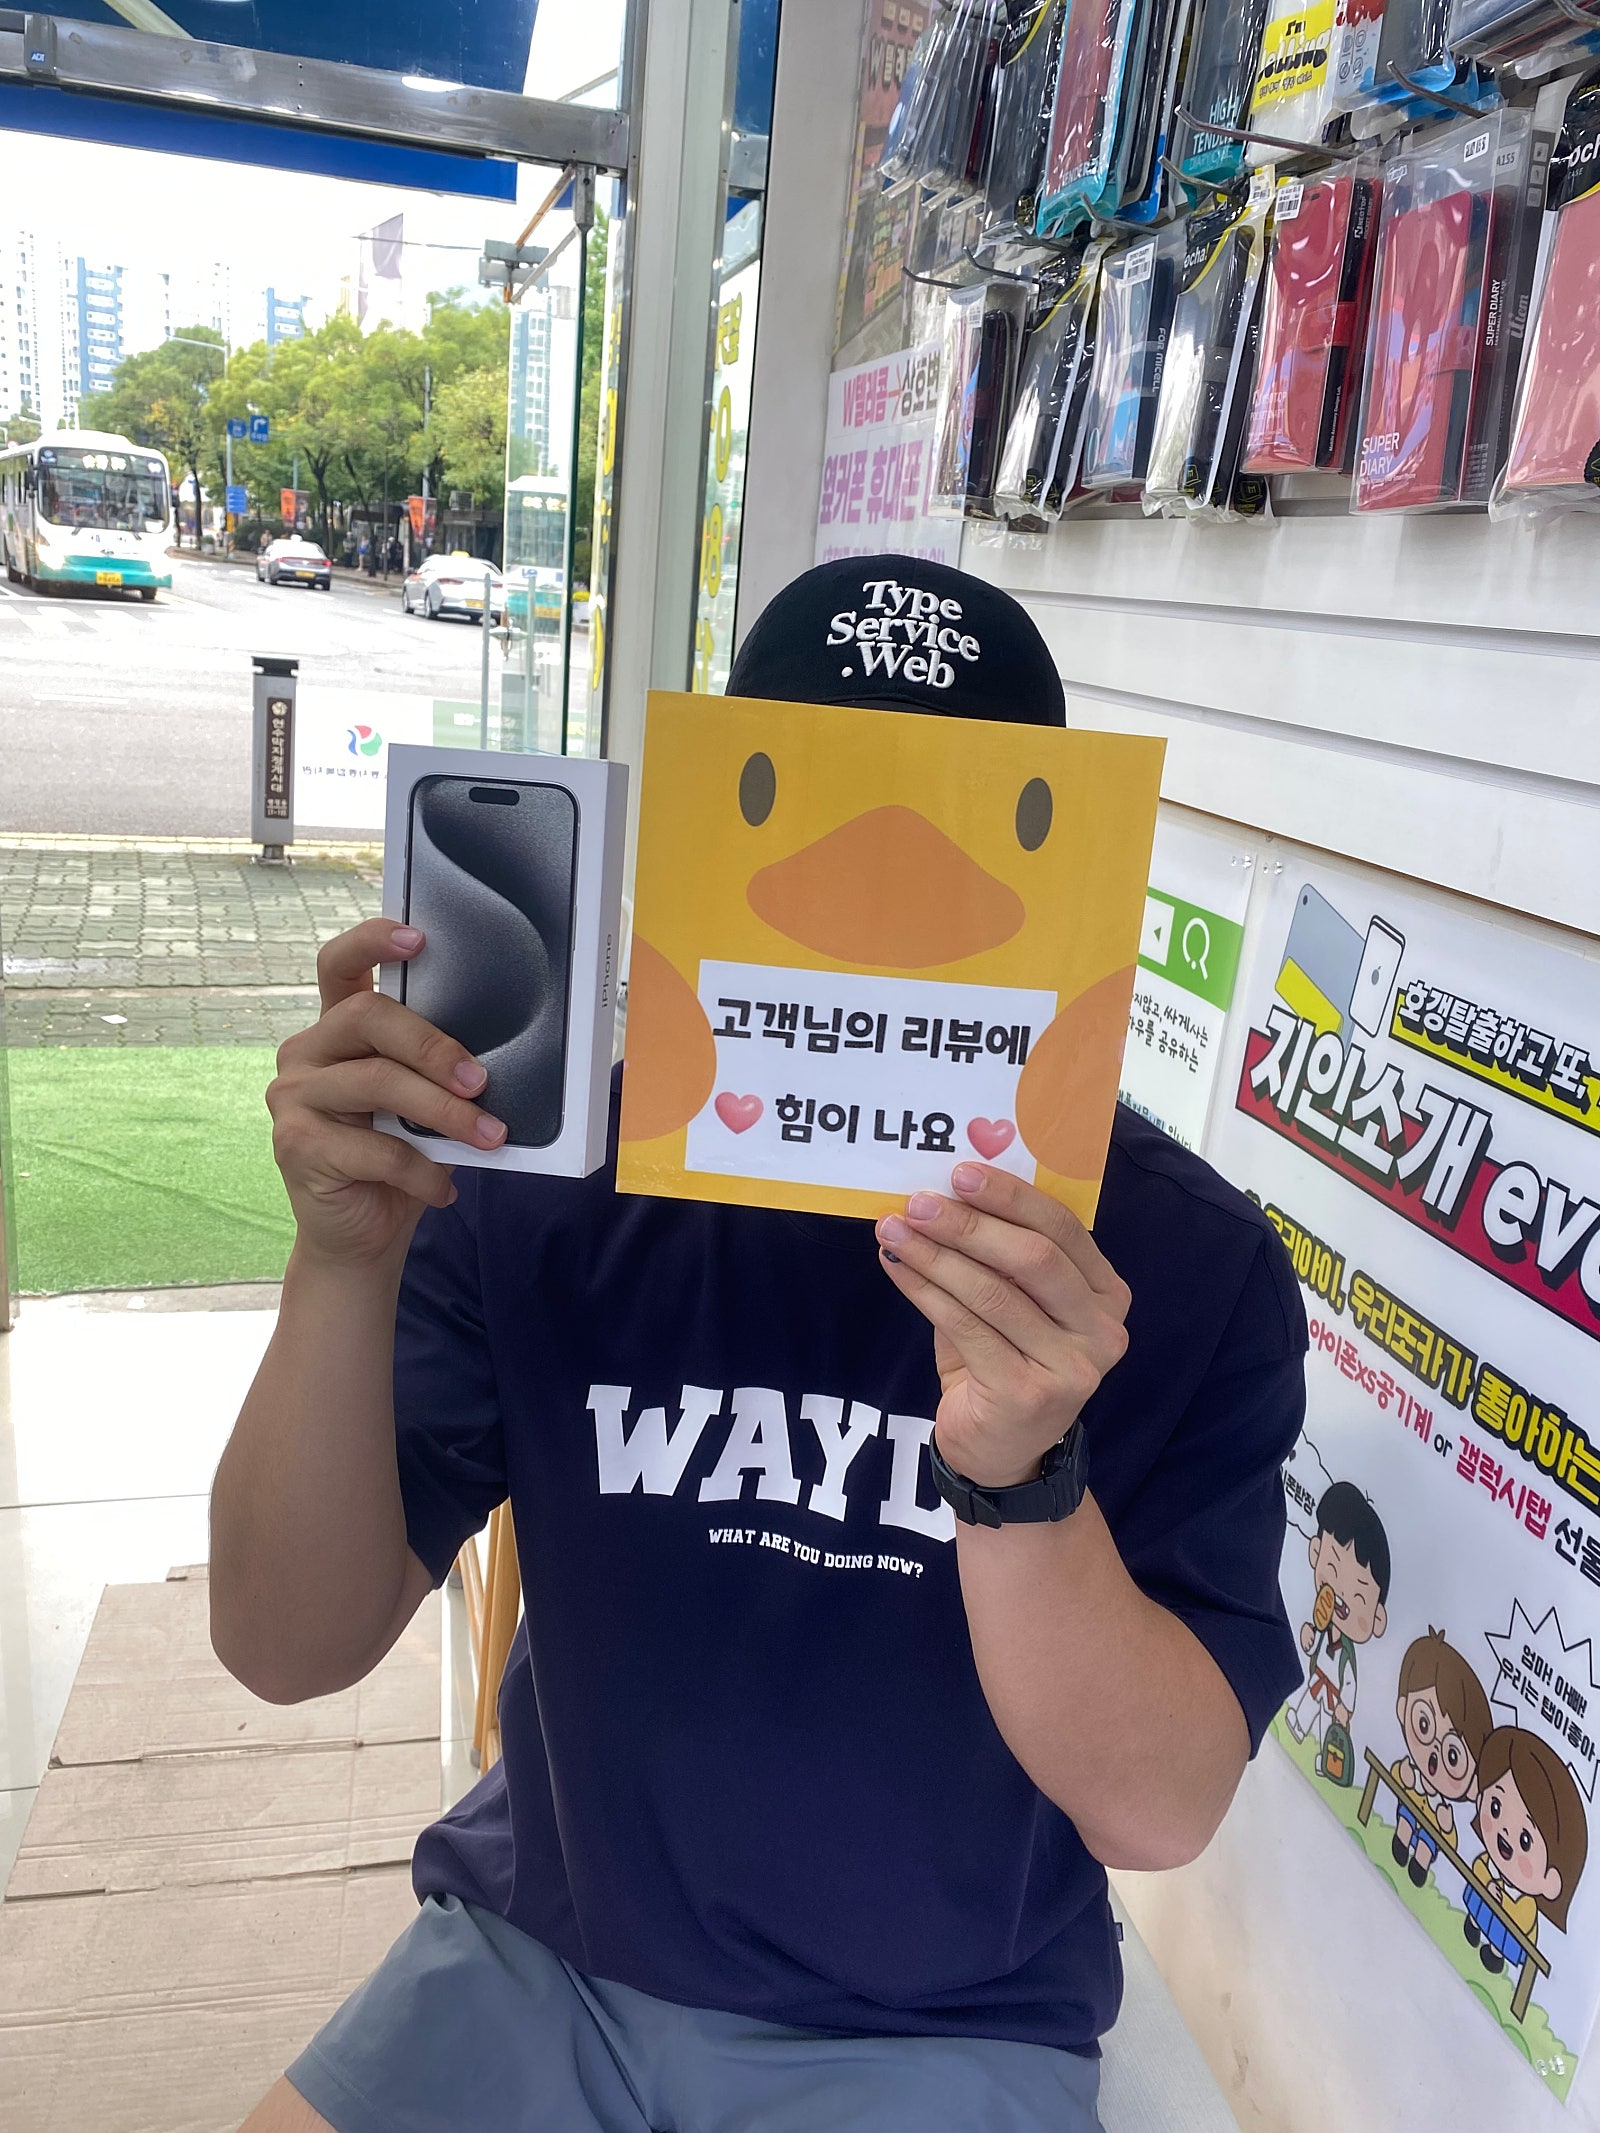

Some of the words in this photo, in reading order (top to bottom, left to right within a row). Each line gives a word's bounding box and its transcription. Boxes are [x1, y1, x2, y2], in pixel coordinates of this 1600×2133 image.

[1489, 279, 1501, 311] DIARY
[1485, 311, 1498, 346] SUPER
[1360, 455, 1394, 477] DIARY
[1361, 432, 1400, 455] SUPER
[866, 439, 924, 525] 휴대폰
[862, 579, 963, 621] Type
[827, 611, 981, 663] Service
[840, 641, 955, 690] .Web
[601, 933, 612, 1008] iPhone
[712, 996, 888, 1054] 고객님의
[900, 1014, 1031, 1066] 리뷰에
[1132, 993, 1163, 1024] 지않고,
[1158, 1030, 1199, 1073] 공유하는
[1398, 979, 1556, 1079] 호갱탈출하고
[1549, 1042, 1590, 1099] 또,
[775, 1093, 861, 1144] 힘이
[873, 1108, 956, 1154] 나요
[1248, 1006, 1492, 1216] 지인소개
[1350, 1275, 1473, 1404] 우리조카가
[1475, 1368, 1600, 1506] 좋아하는
[1434, 1433, 1453, 1458] or
[1456, 1434, 1552, 1541] 갤럭시탭
[708, 1528, 756, 1544] WHAT
[759, 1531, 790, 1554] ARE
[793, 1540, 820, 1565] YOU
[823, 1552, 873, 1570] DOING
[876, 1554, 924, 1579] NOW?
[1521, 1644, 1554, 1687] 엄마!
[1554, 1675, 1588, 1719] 아빠!
[1501, 1657, 1539, 1708] 우리는
[1540, 1694, 1596, 1763] 탭이좋아
